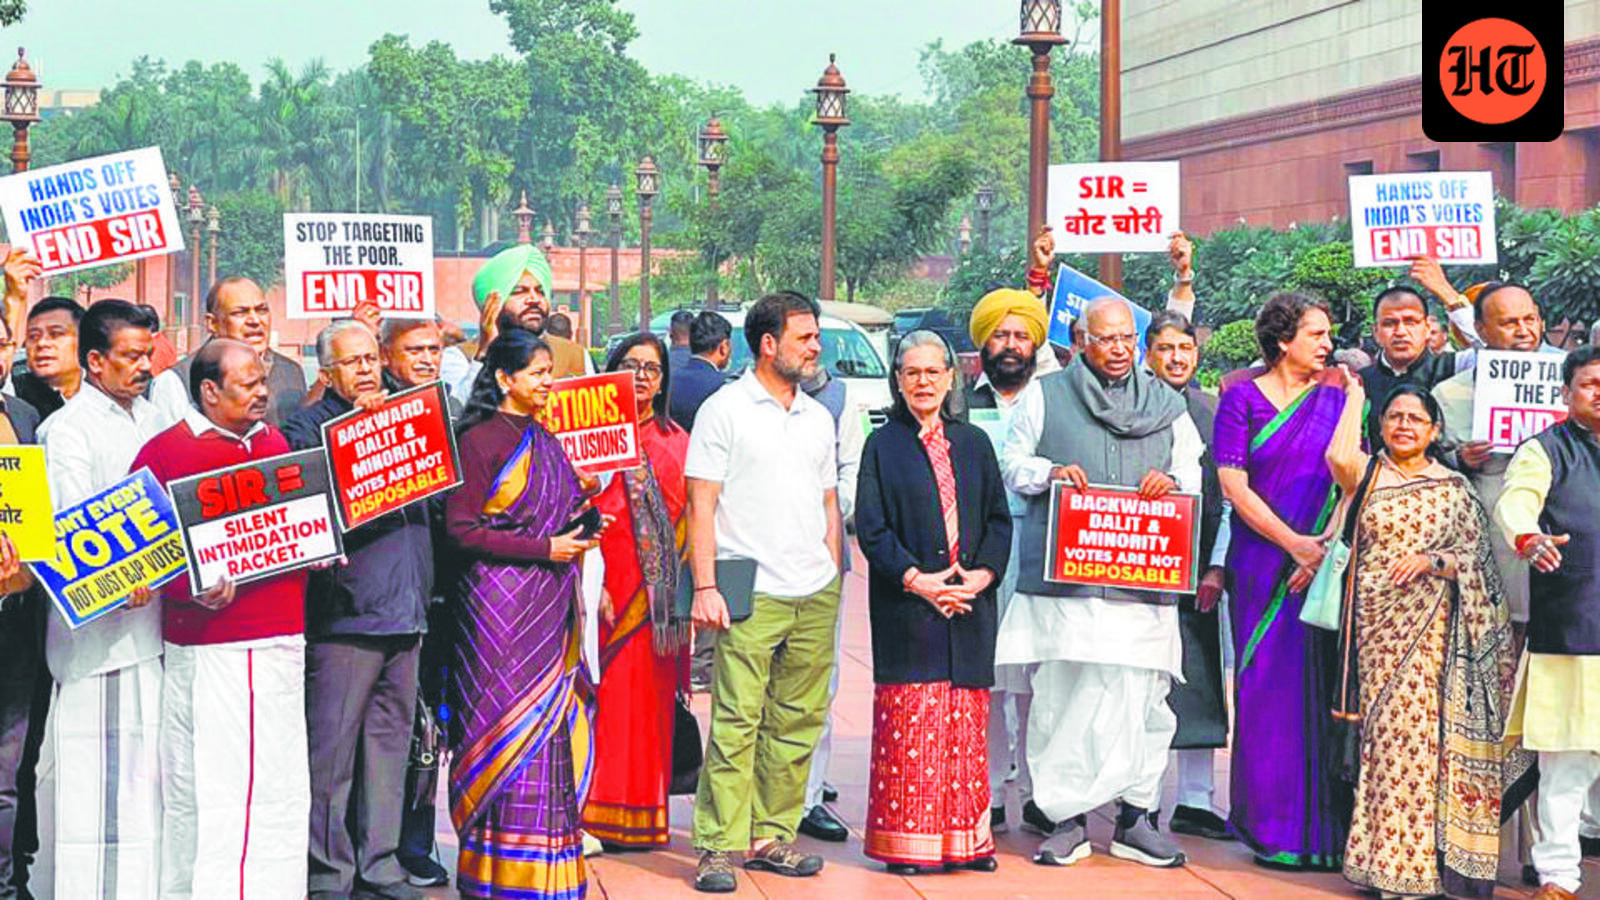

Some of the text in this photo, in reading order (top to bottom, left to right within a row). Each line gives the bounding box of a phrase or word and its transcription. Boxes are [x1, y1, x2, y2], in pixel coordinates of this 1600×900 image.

[29, 160, 136, 201] HANDS OFF
[1079, 176, 1147, 199] SIR =
[1376, 179, 1468, 202] HANDS OFF
[20, 185, 160, 232] INDIA'S VOTES
[1064, 206, 1163, 235] वोट चोरी
[1364, 203, 1483, 227] INDIA'S VOTES
[35, 213, 164, 269] END SIR
[297, 222, 423, 243] STOP TARGETING
[1373, 227, 1479, 260] END SIR
[323, 245, 403, 266] THE POOR.
[307, 272, 423, 310] END SIR
[1489, 359, 1563, 382] STOP TA
[1514, 383, 1544, 404] THE
[355, 423, 416, 459] DALIT &
[564, 428, 628, 462] CLUSIONS
[351, 436, 428, 480] MINORITY
[197, 465, 304, 519] SIR =
[346, 451, 443, 500] VOTES ARE NOT
[86, 479, 146, 520] EVERY
[350, 466, 448, 520] DISPOSABLE
[225, 507, 288, 538] SILENT
[1089, 513, 1160, 534] DALIT &
[44, 499, 170, 581] VOTE
[197, 517, 328, 565] INTIMIDATION
[1078, 530, 1170, 552] MINORITY
[227, 545, 305, 576] RACKET.
[1064, 547, 1182, 568] VOTES ARE NOT
[1064, 561, 1181, 585] DISPOSABLE
[67, 539, 186, 612] NOT JUST BJP VOTES
